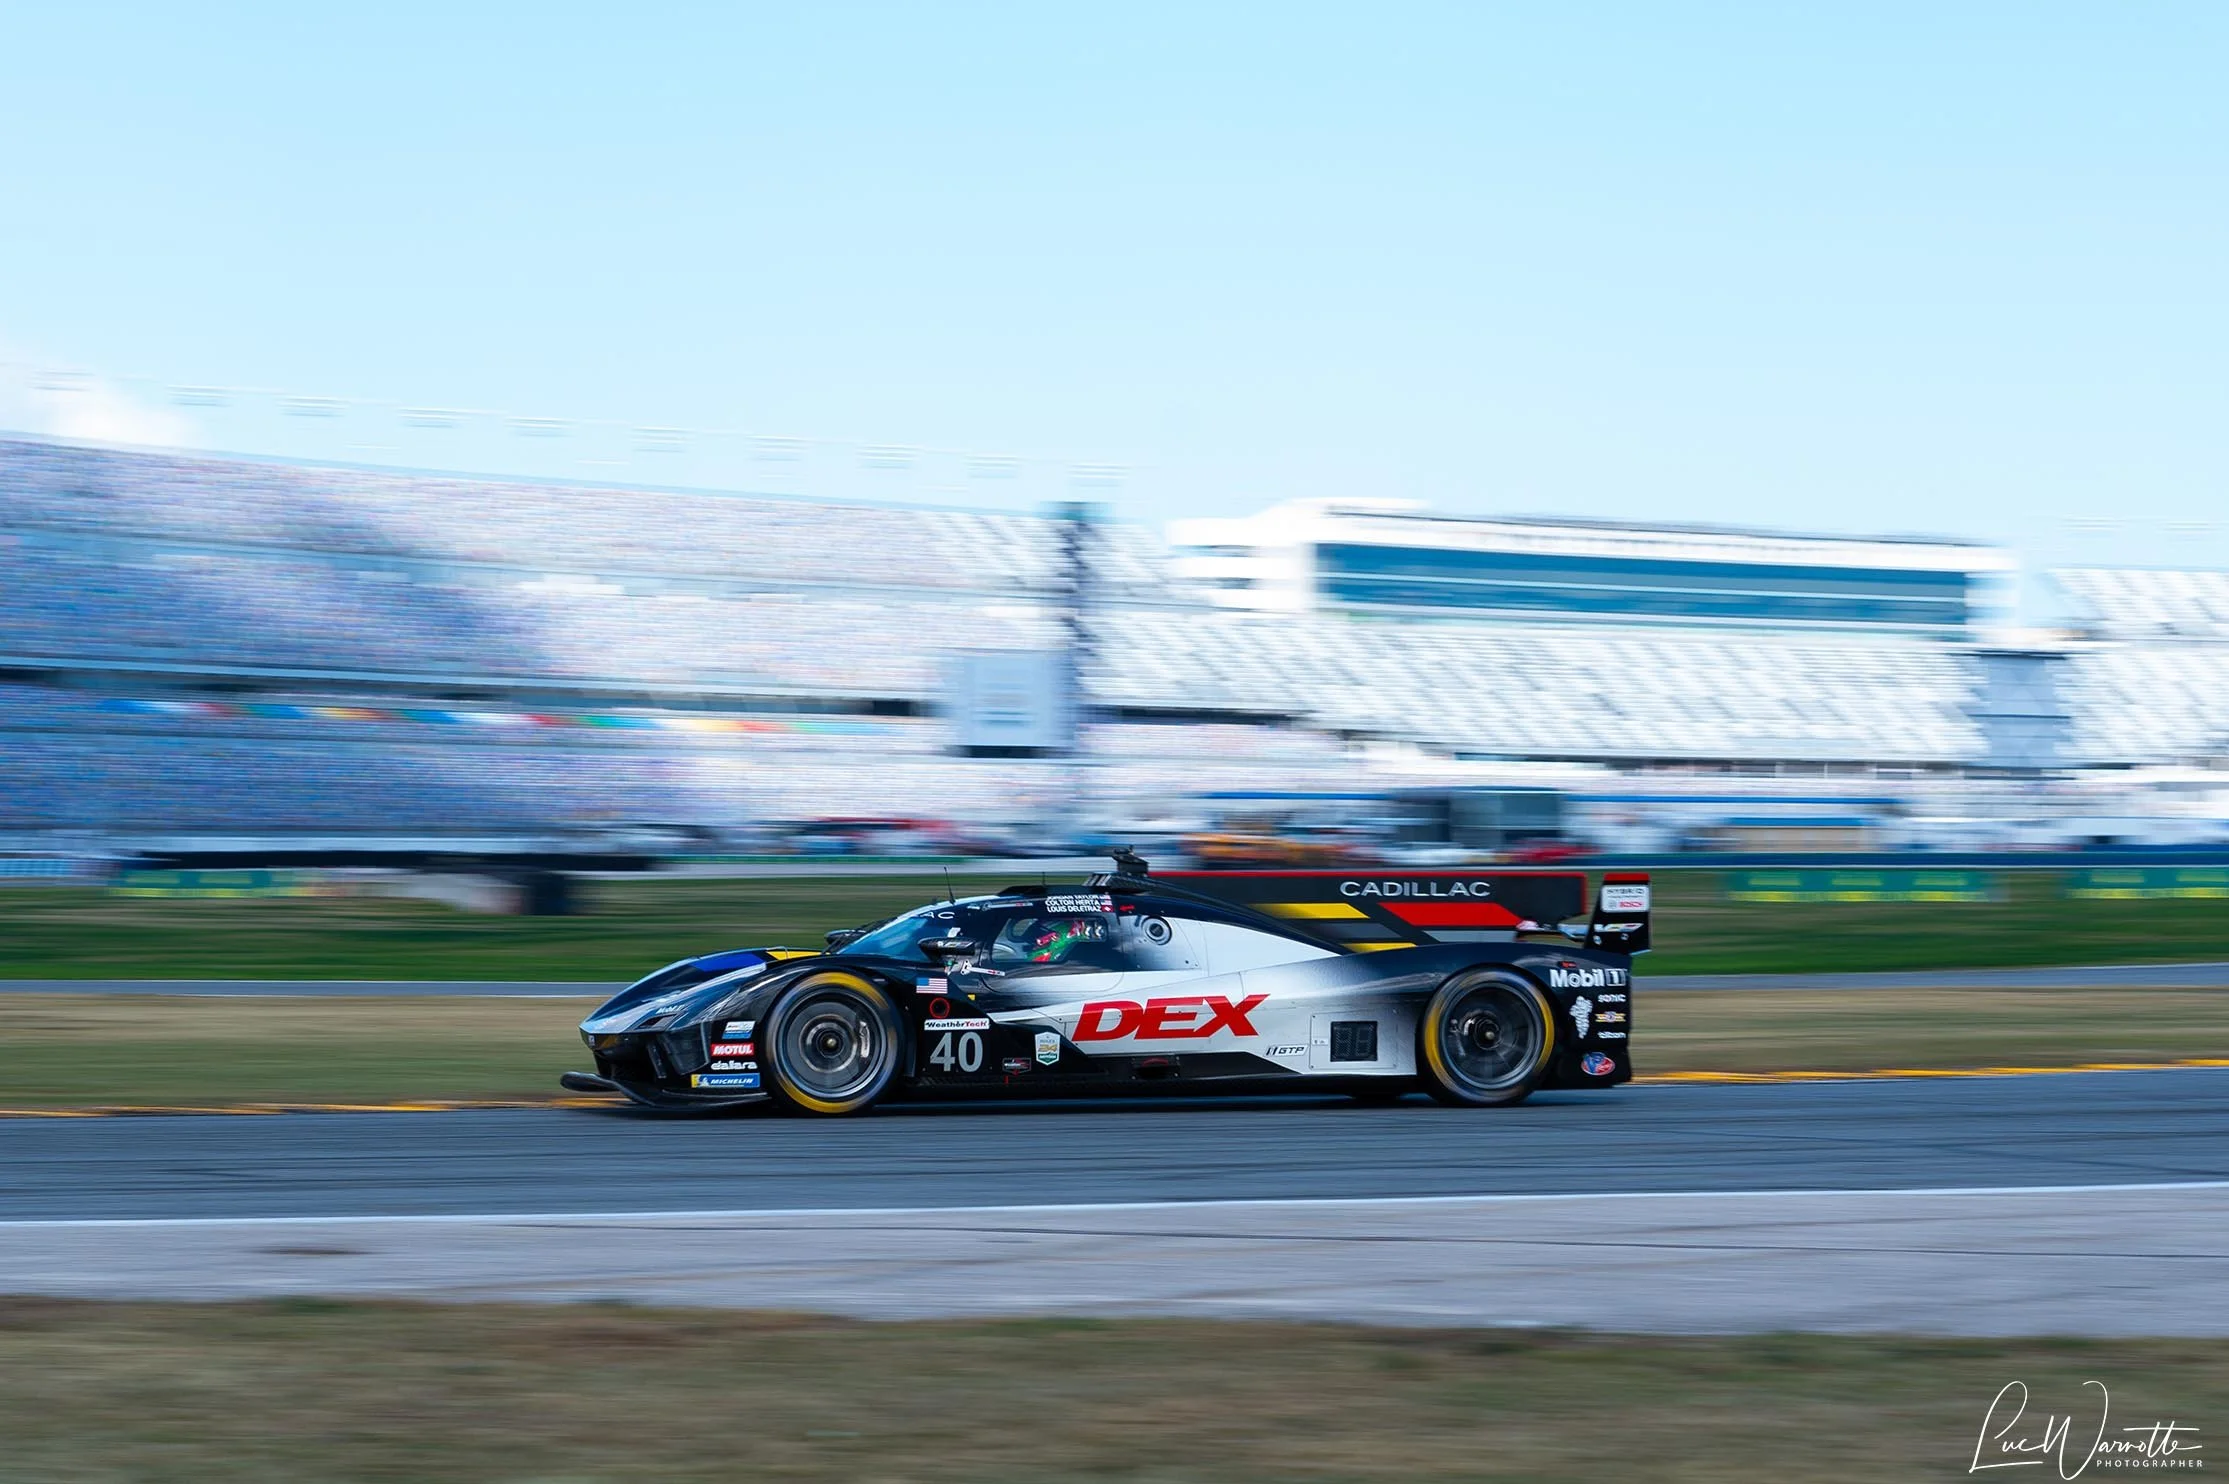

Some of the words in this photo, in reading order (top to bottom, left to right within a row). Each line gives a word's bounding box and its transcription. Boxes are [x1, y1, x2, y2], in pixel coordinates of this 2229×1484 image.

[1340, 881, 1490, 897] CADILLAC
[1549, 968, 1605, 987] Mobil
[1071, 994, 1271, 1042] DEX
[712, 1045, 753, 1055] MOTUL
[930, 1031, 983, 1072] 40
[1278, 1046, 1305, 1055] GTP
